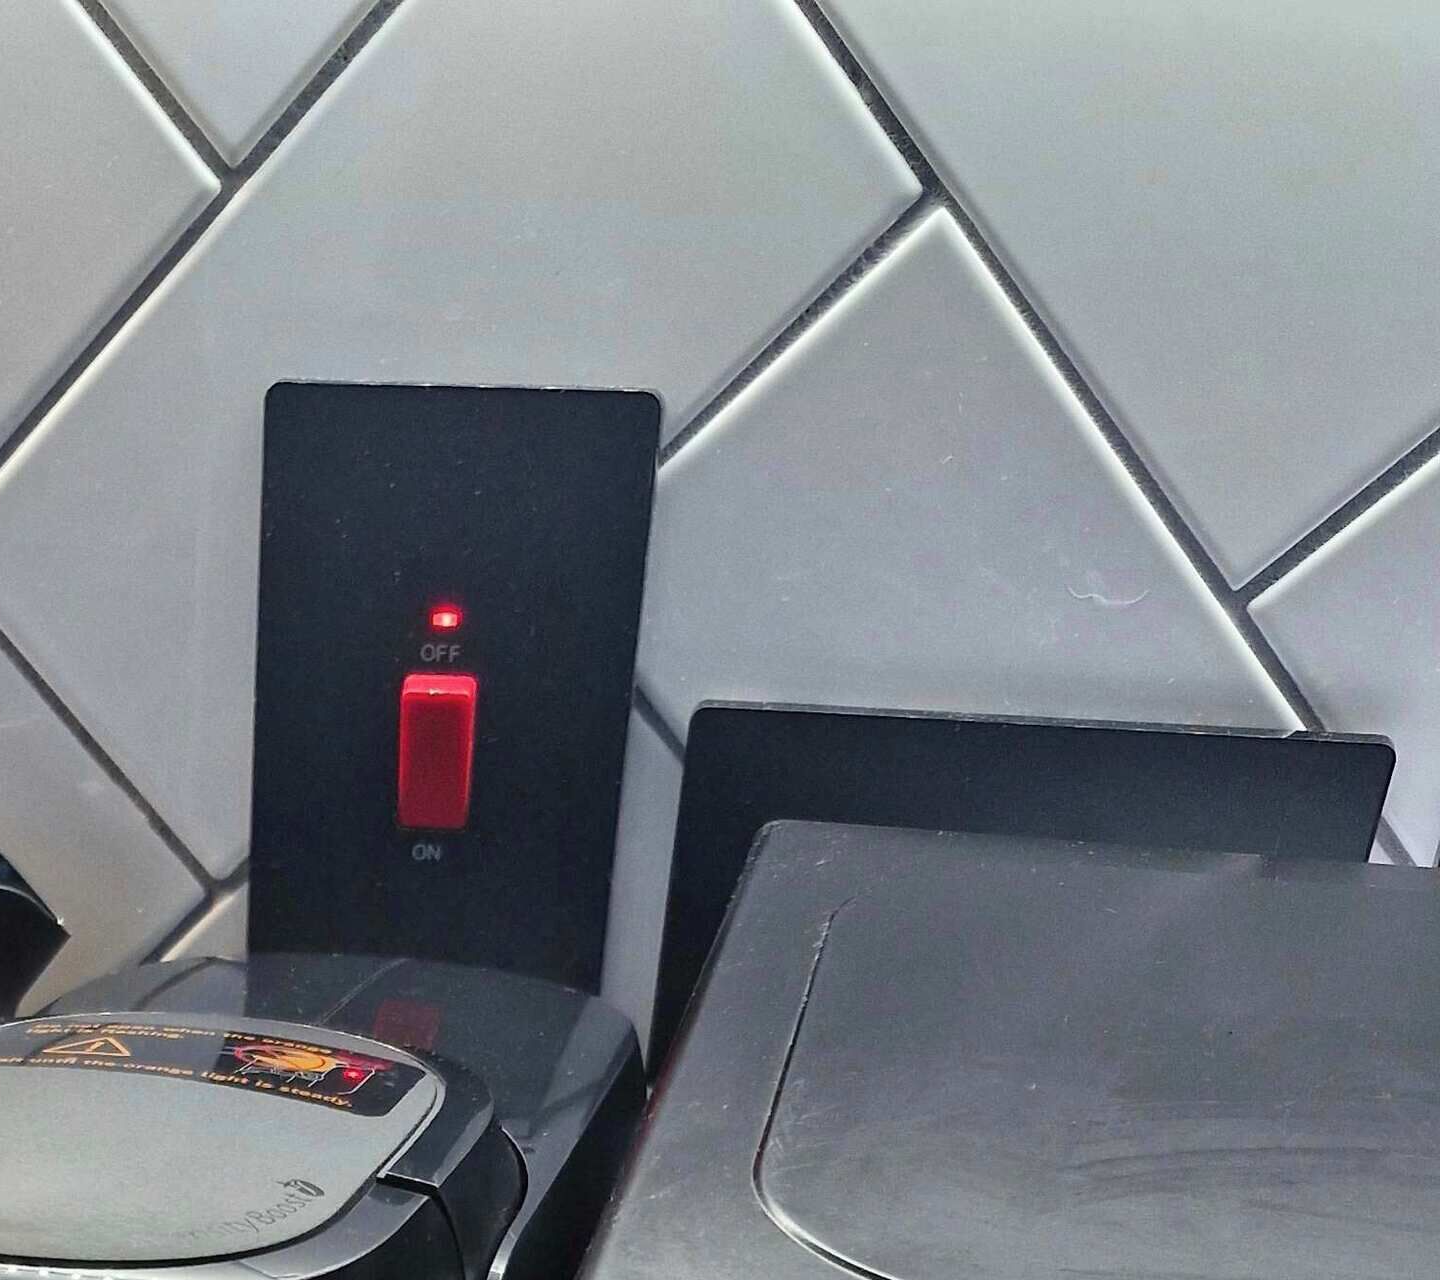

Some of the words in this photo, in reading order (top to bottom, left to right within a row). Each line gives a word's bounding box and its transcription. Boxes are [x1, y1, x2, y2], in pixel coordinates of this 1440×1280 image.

[419, 643, 461, 663] OFF
[411, 843, 442, 862] ON
[106, 1023, 155, 1031] open
[163, 1026, 216, 1036] when
[224, 1031, 255, 1040] the
[262, 1038, 332, 1054] orange
[29, 1056, 78, 1065] until
[83, 1059, 116, 1067] the
[123, 1063, 194, 1075] orange
[200, 1071, 249, 1085] light
[254, 1080, 274, 1089] is
[278, 1086, 353, 1107] steady.
